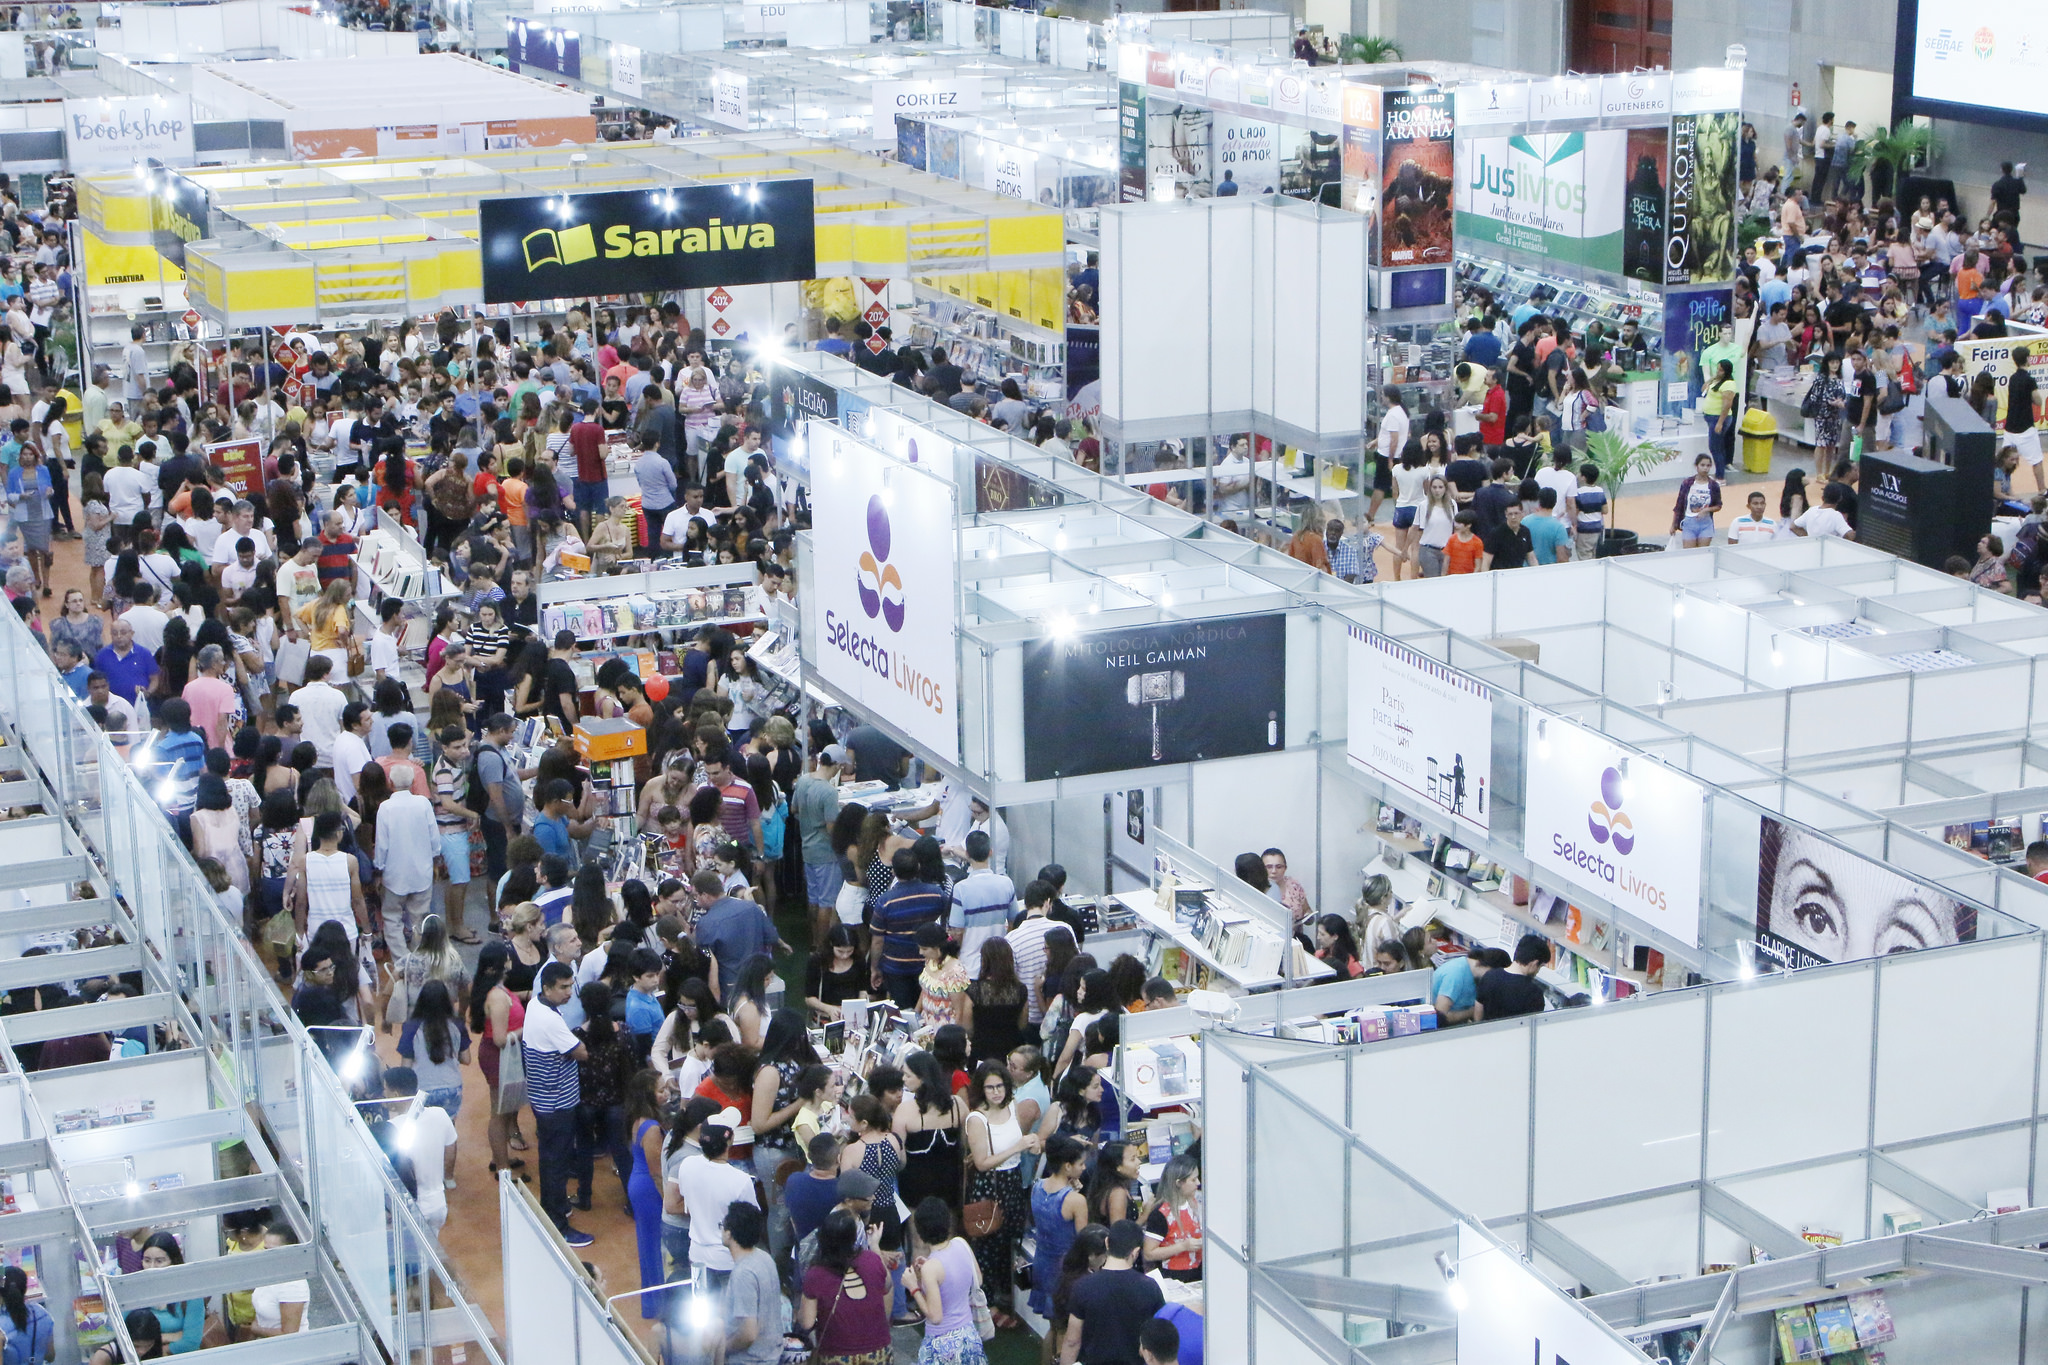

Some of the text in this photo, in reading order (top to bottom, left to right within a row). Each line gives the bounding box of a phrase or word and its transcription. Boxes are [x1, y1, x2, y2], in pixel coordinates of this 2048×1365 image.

[760, 6, 786, 17] EDU
[1924, 37, 1964, 52] SEBRAE
[720, 82, 740, 99] CORTEZ
[896, 92, 958, 107] CORTEZ
[1394, 94, 1445, 105] NEIL KLEID
[1607, 100, 1664, 112] GUTENBERG
[719, 100, 742, 118] EDITORA
[1387, 107, 1450, 123] HOMEM-
[73, 107, 185, 141] Bookshop
[1386, 122, 1454, 140] ARANHA
[1228, 127, 1266, 140] O LADO
[1222, 149, 1271, 163] DO AMOR
[996, 160, 1021, 178] QUEEN
[996, 179, 1022, 199] BOOKS
[1667, 120, 1690, 269] QUIXOTE
[1522, 213, 1527, 223] e
[603, 218, 775, 259] Saraiva
[1513, 226, 1542, 242] Literatura
[1392, 250, 1414, 260] MARVEL
[105, 274, 145, 284] LITERATURA
[1586, 284, 1600, 296] Caixa
[1643, 292, 1658, 304] Caixa
[712, 294, 729, 307] 20%
[868, 311, 885, 323] 20%
[1695, 321, 1719, 351] Pan
[1972, 346, 2009, 361] Feira
[1983, 363, 1997, 373] do
[798, 387, 828, 417] LEGIÃO
[1871, 487, 1884, 496] NOVA
[1064, 636, 1159, 658] MITOLOGIA
[826, 609, 943, 715] Selecta Livros
[1106, 646, 1206, 668] NEIL GAIMAN
[1382, 687, 1405, 713] Paris
[1373, 708, 1414, 738] para dois
[1397, 734, 1410, 750] um
[1372, 744, 1415, 775] JOJO MOYES
[1553, 832, 1667, 911] Selecta Livros
[1761, 933, 1796, 967] CLARICE
[1635, 1335, 1650, 1344] 20.00
